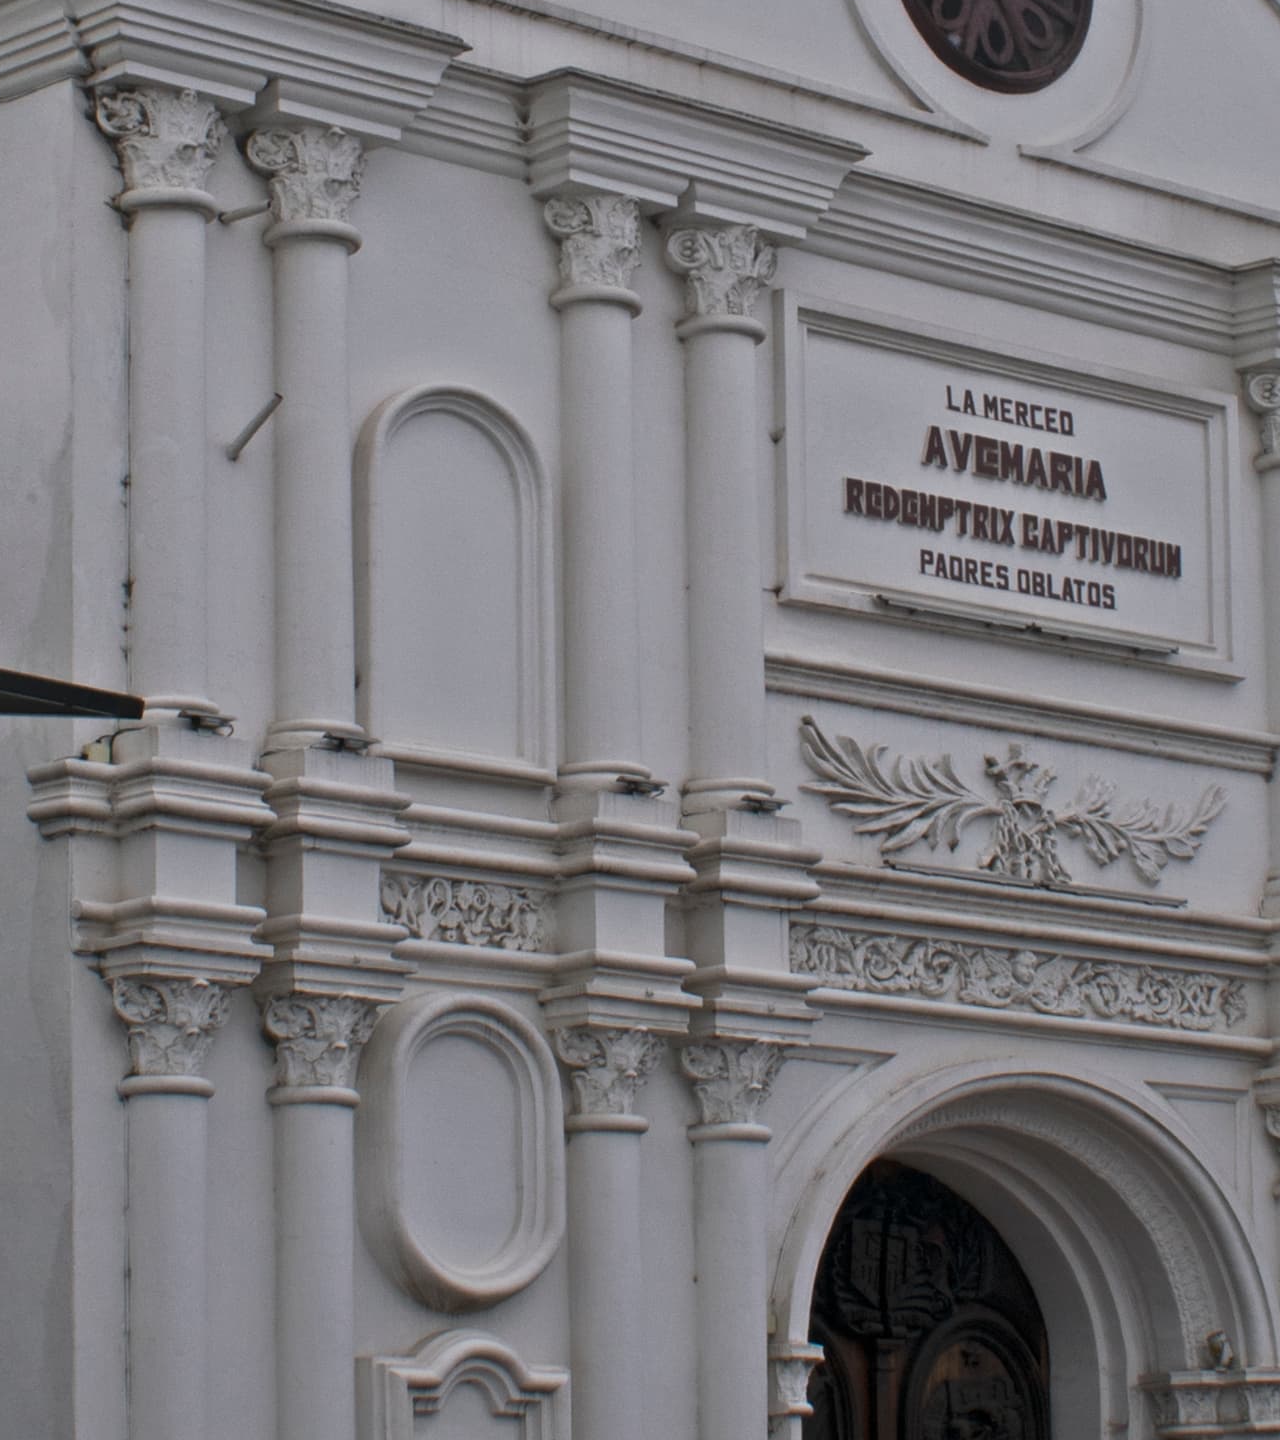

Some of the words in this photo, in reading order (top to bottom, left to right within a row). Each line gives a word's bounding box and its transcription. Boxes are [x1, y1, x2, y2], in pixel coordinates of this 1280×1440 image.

[946, 385, 976, 417] LA
[983, 394, 1075, 436] MERCED
[844, 477, 1016, 545] REDEMPTRIX
[1020, 513, 1182, 579] CAPTIVORUM
[920, 549, 1010, 590] PADRES
[1017, 569, 1117, 610] OBLATOS
